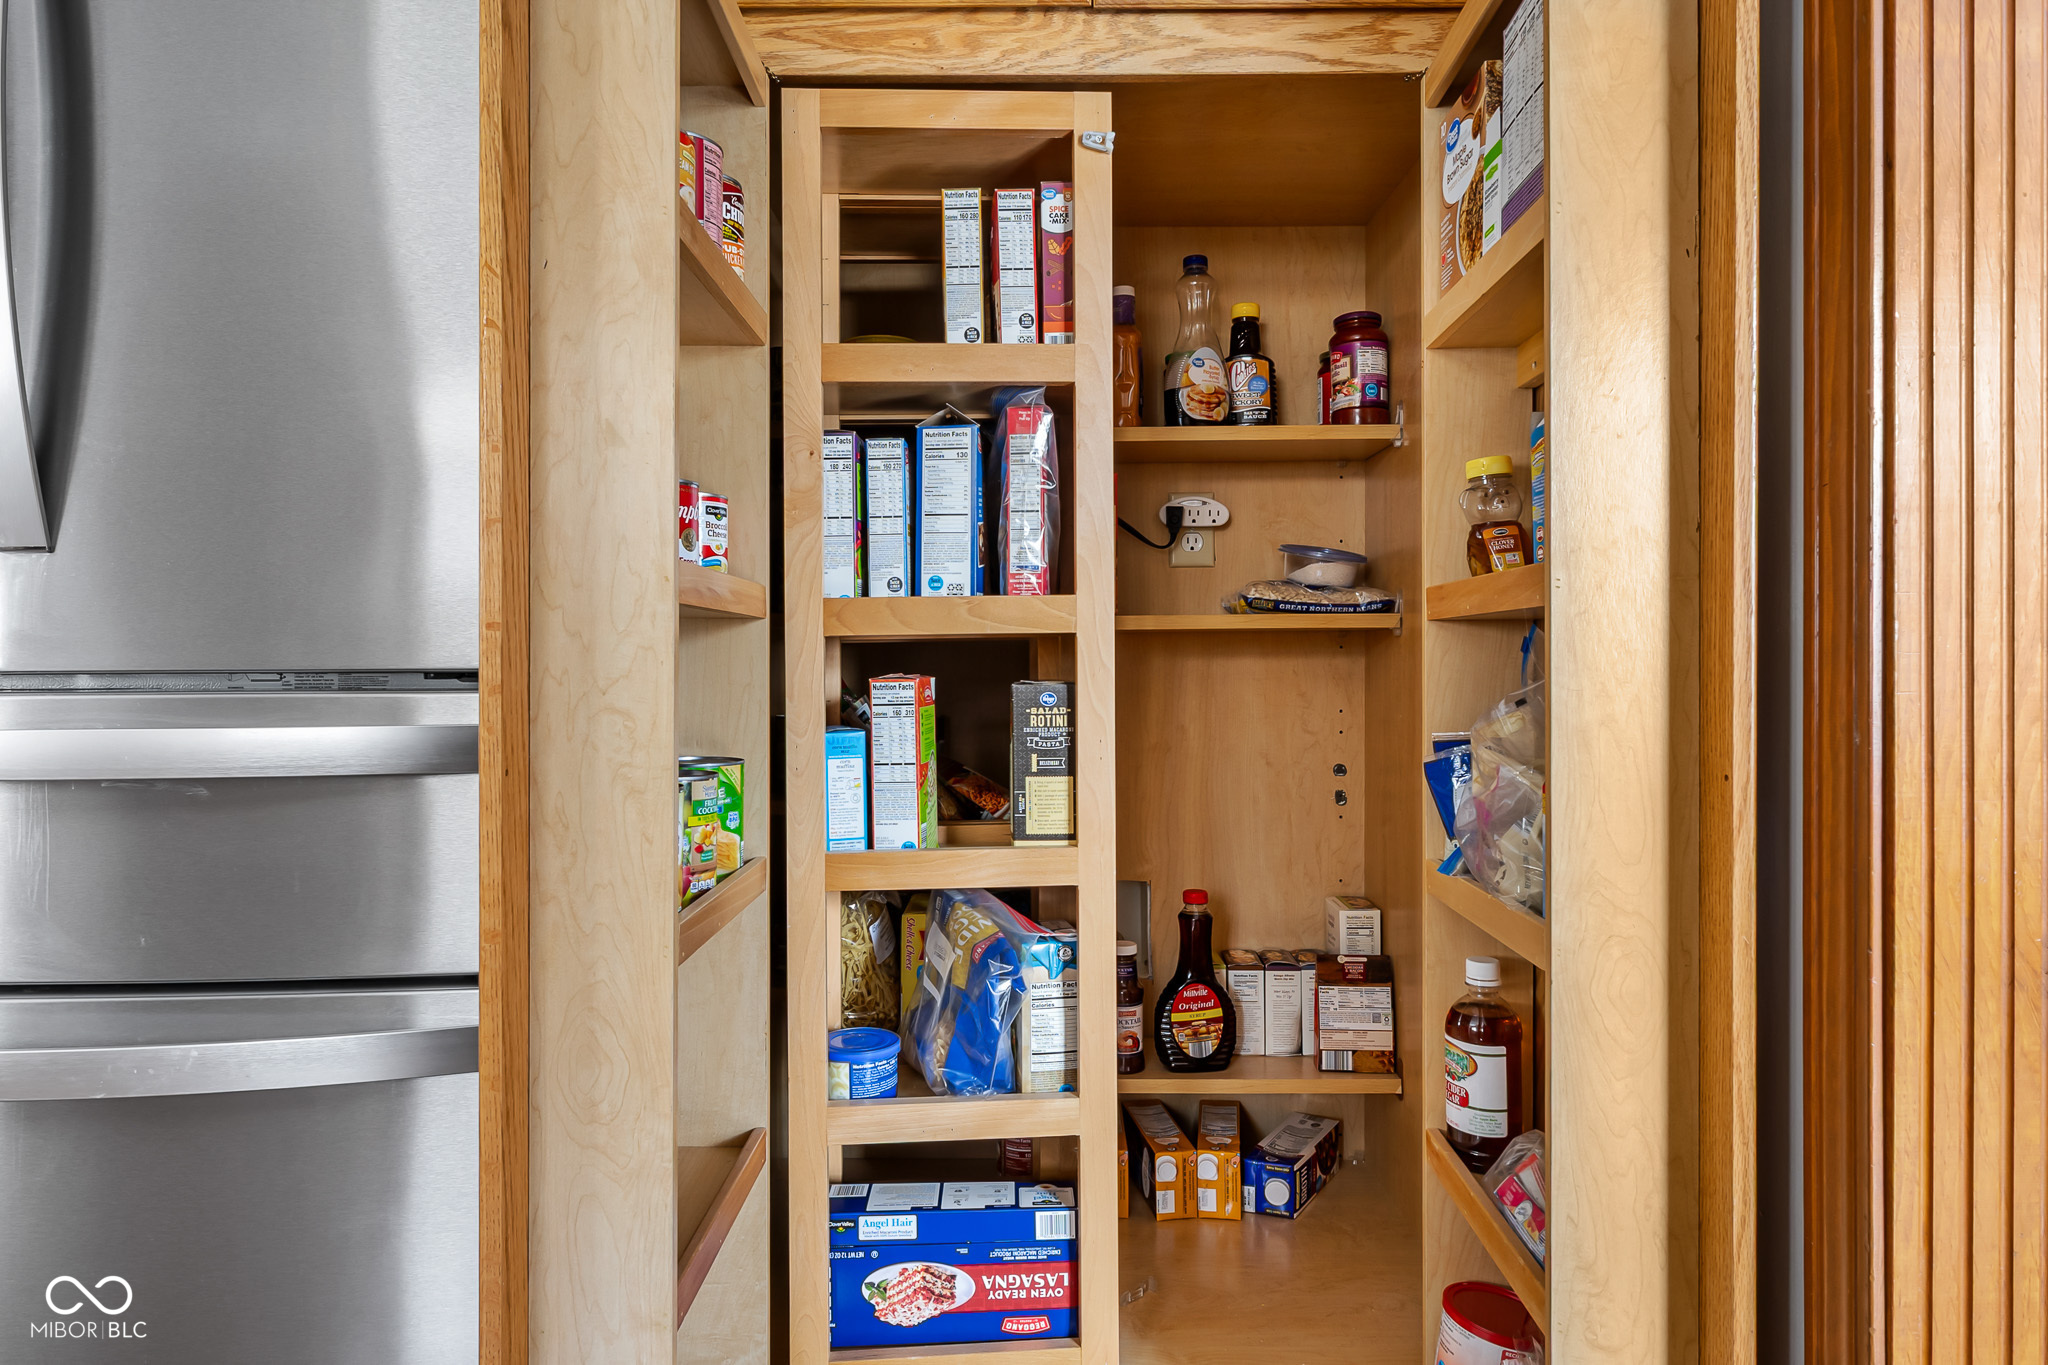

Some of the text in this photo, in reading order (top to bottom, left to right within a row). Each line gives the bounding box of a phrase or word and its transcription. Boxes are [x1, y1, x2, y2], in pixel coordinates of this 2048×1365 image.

[1452, 144, 1467, 166] Maple
[1446, 148, 1474, 185] Brown Sugar
[944, 190, 978, 199] Nutrition Facts
[1019, 192, 1032, 200] Facts
[1049, 205, 1069, 213] SPICE
[835, 437, 852, 445] Facts
[888, 441, 901, 449] Facts
[707, 529, 728, 539] Cheese
[1493, 543, 1514, 551] HONEY
[1279, 603, 1307, 611] GREAT
[898, 683, 914, 691] Facts
[1030, 707, 1067, 715] SALAD
[1030, 715, 1068, 727] ROTINI
[906, 917, 916, 938] Shells
[905, 945, 915, 971] Cheese
[1183, 988, 1208, 998] Millville
[1178, 999, 1214, 1011] Original
[1447, 1081, 1466, 1098] CIDER
[1300, 1166, 1308, 1204] BROTH
[862, 1217, 913, 1230] Angel Hair
[847, 1251, 856, 1259] WT
[856, 1251, 865, 1259] NET
[981, 1272, 1069, 1290] LASAGNA
[987, 1287, 1064, 1300] OVEN READY
[1006, 1320, 1046, 1331] REGGANO
